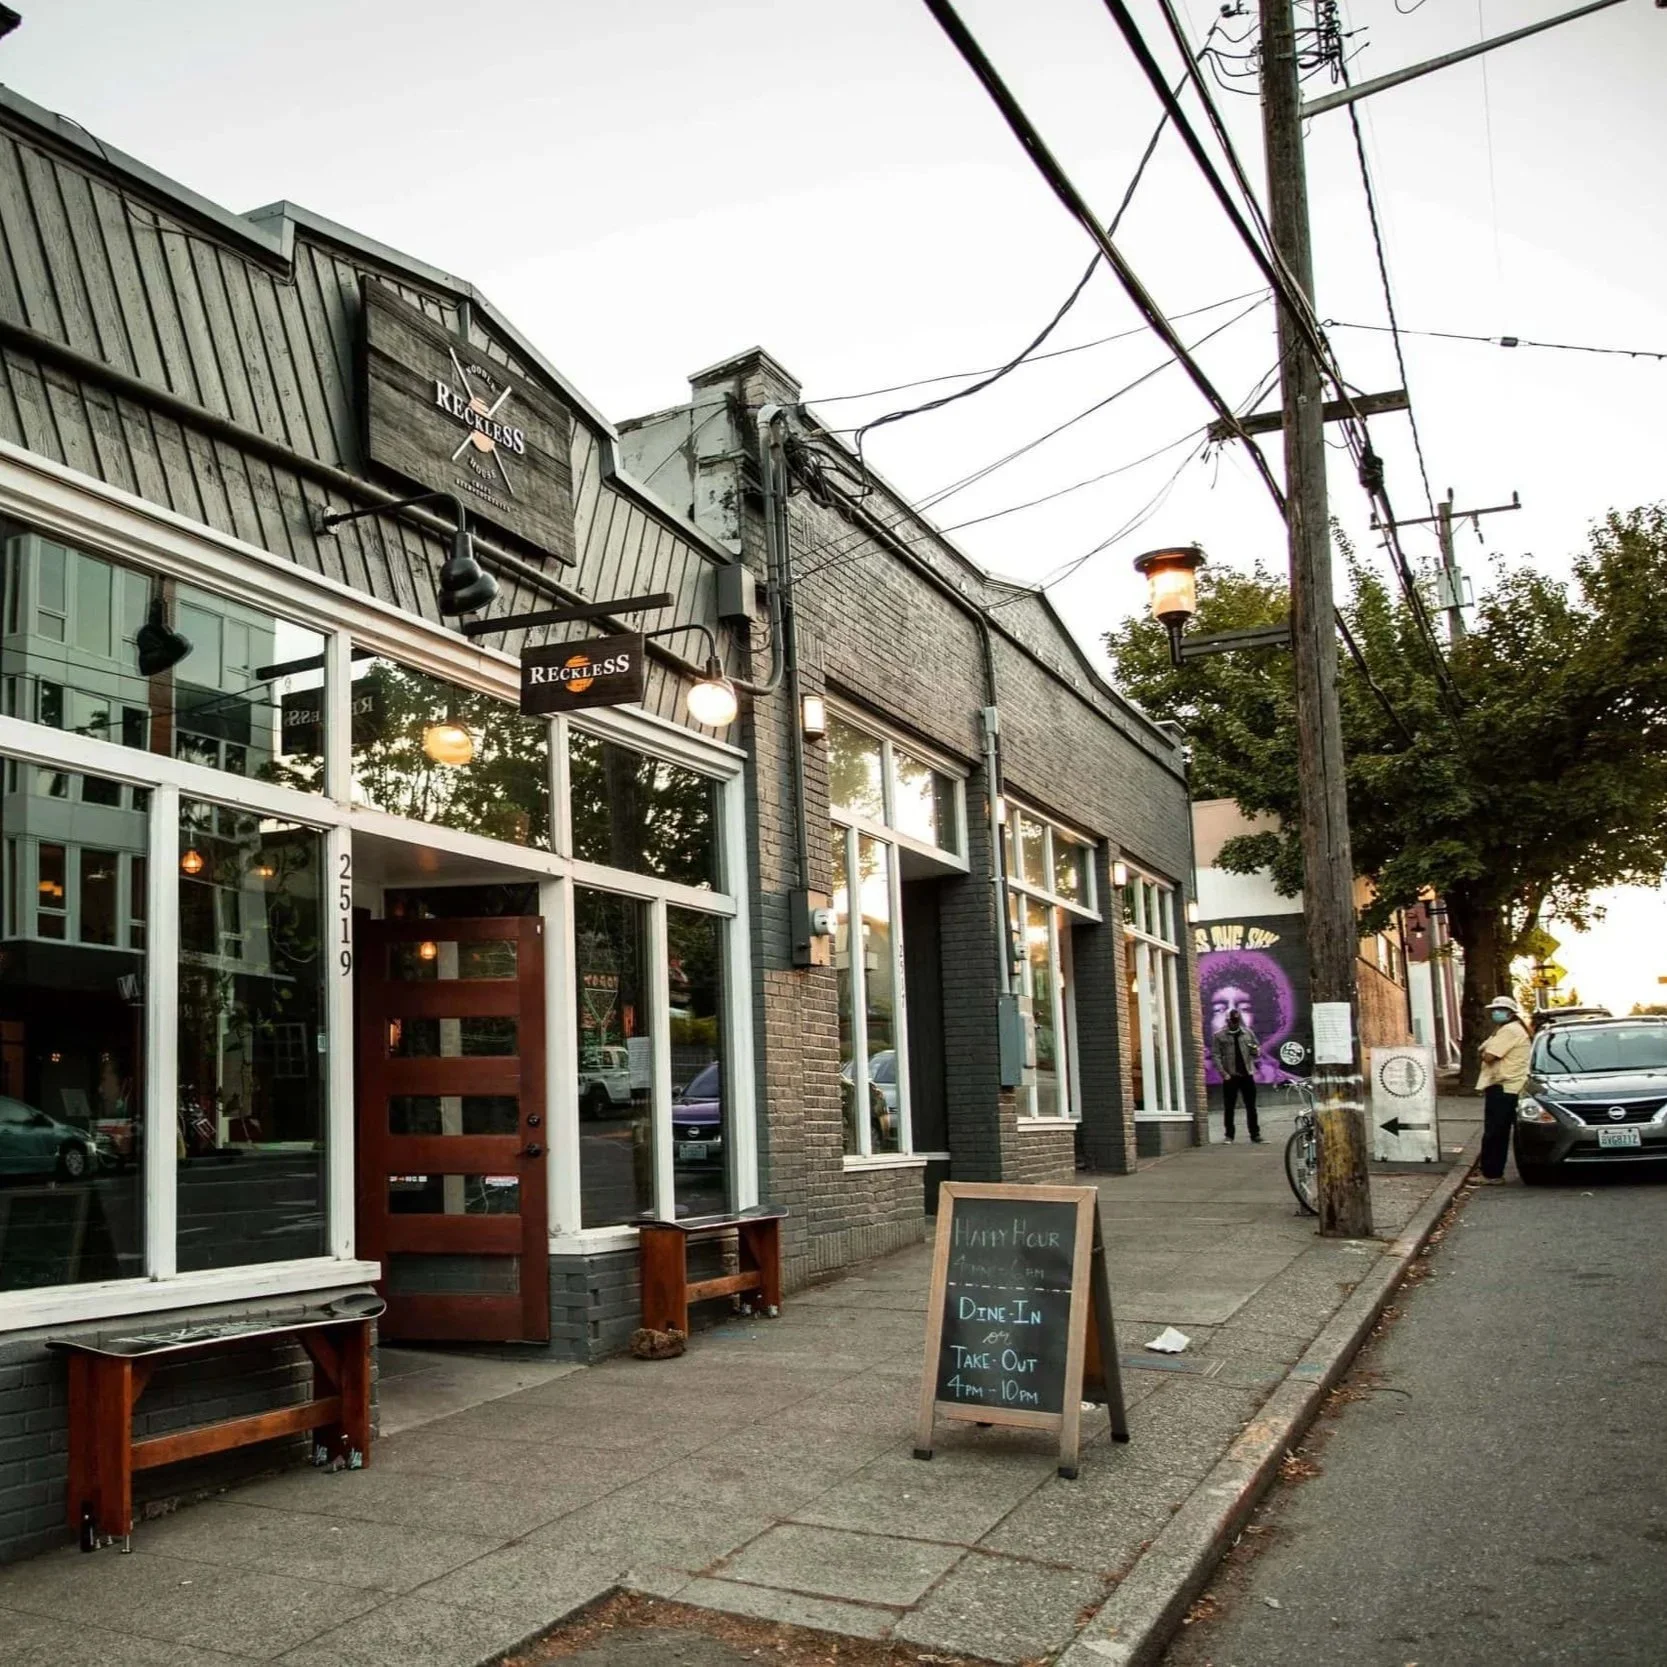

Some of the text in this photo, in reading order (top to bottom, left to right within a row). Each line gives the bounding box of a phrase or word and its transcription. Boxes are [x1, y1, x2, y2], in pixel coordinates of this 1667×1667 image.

[435, 380, 525, 455] RECKLESS
[529, 654, 630, 685] RECKLESS
[340, 854, 351, 976] 2519
[1210, 925, 1244, 952] THE
[1245, 927, 1281, 950] SKY
[955, 1218, 1061, 1248] HAPPY HOUR
[959, 1297, 1041, 1324] DINE-IN
[950, 1345, 1038, 1373] TAKE-OUT
